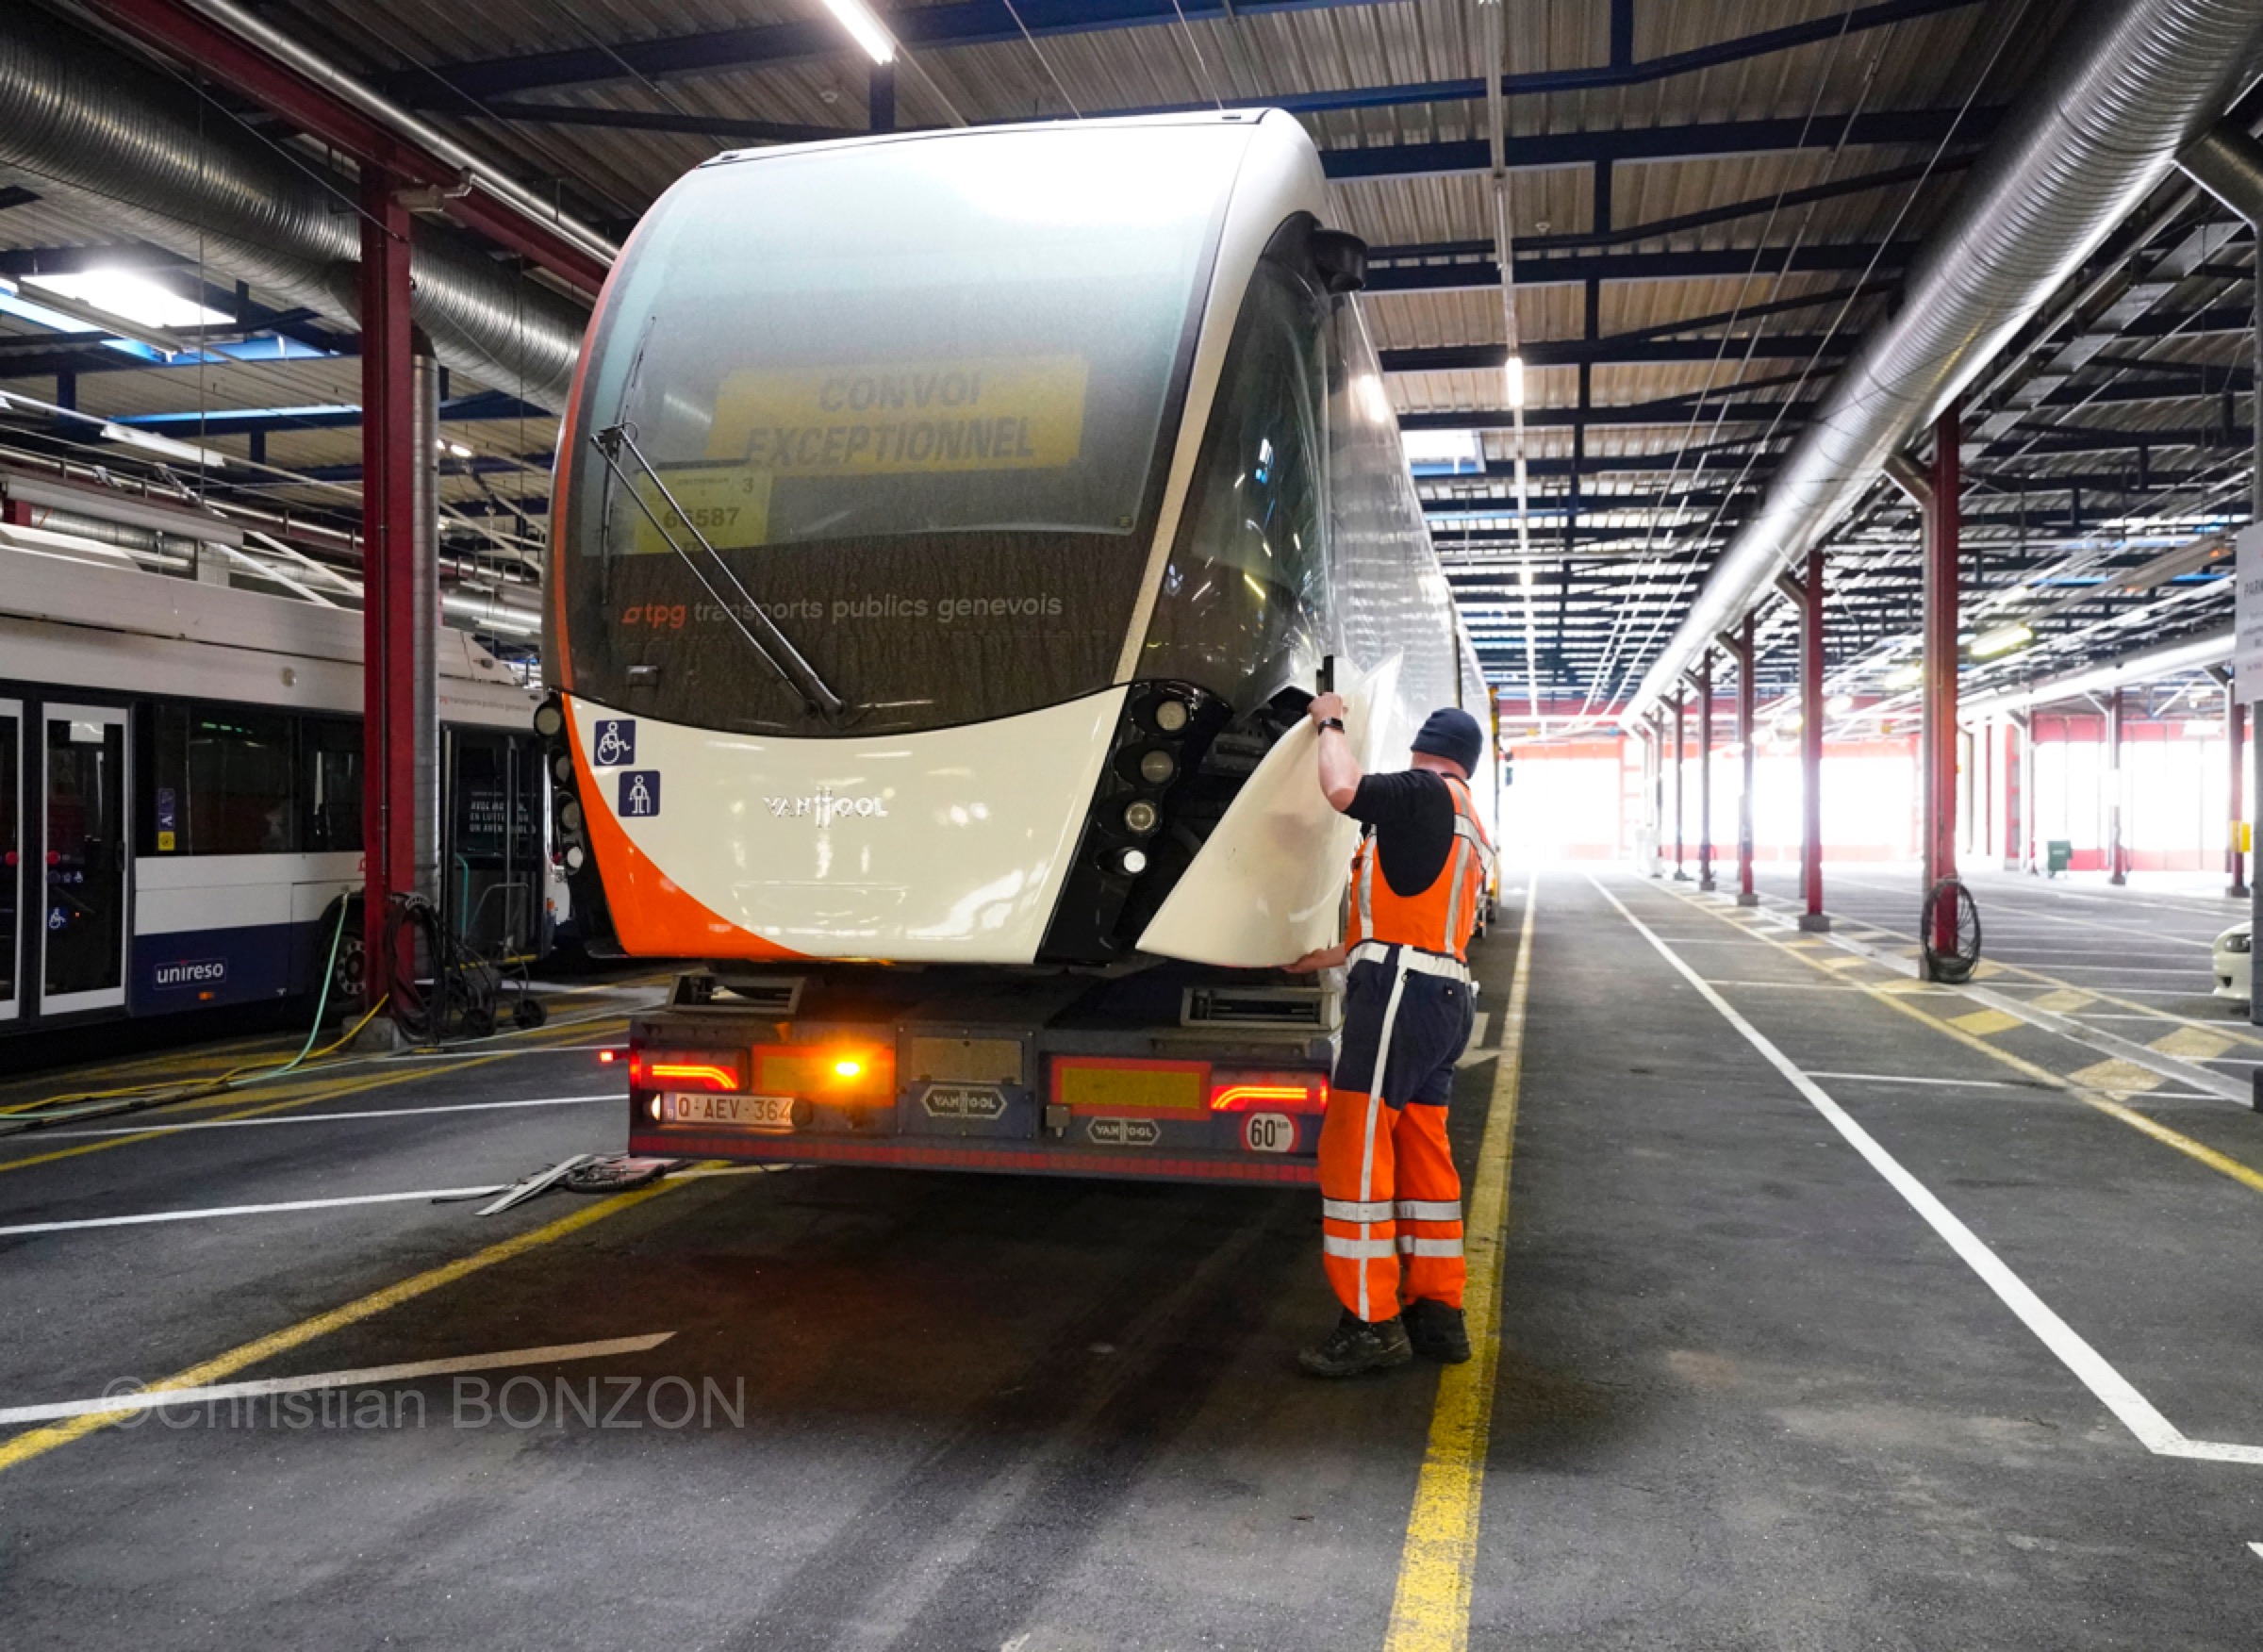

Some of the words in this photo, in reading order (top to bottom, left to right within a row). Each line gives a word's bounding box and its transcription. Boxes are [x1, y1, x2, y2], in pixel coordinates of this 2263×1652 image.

[818, 371, 981, 413] CONVOI
[744, 417, 1034, 467] EXCEPTIONNEL
[693, 598, 823, 626] transports
[832, 593, 929, 624] publics
[937, 593, 1063, 623] genevois
[157, 959, 224, 984] unireso
[1251, 1117, 1276, 1148] 60
